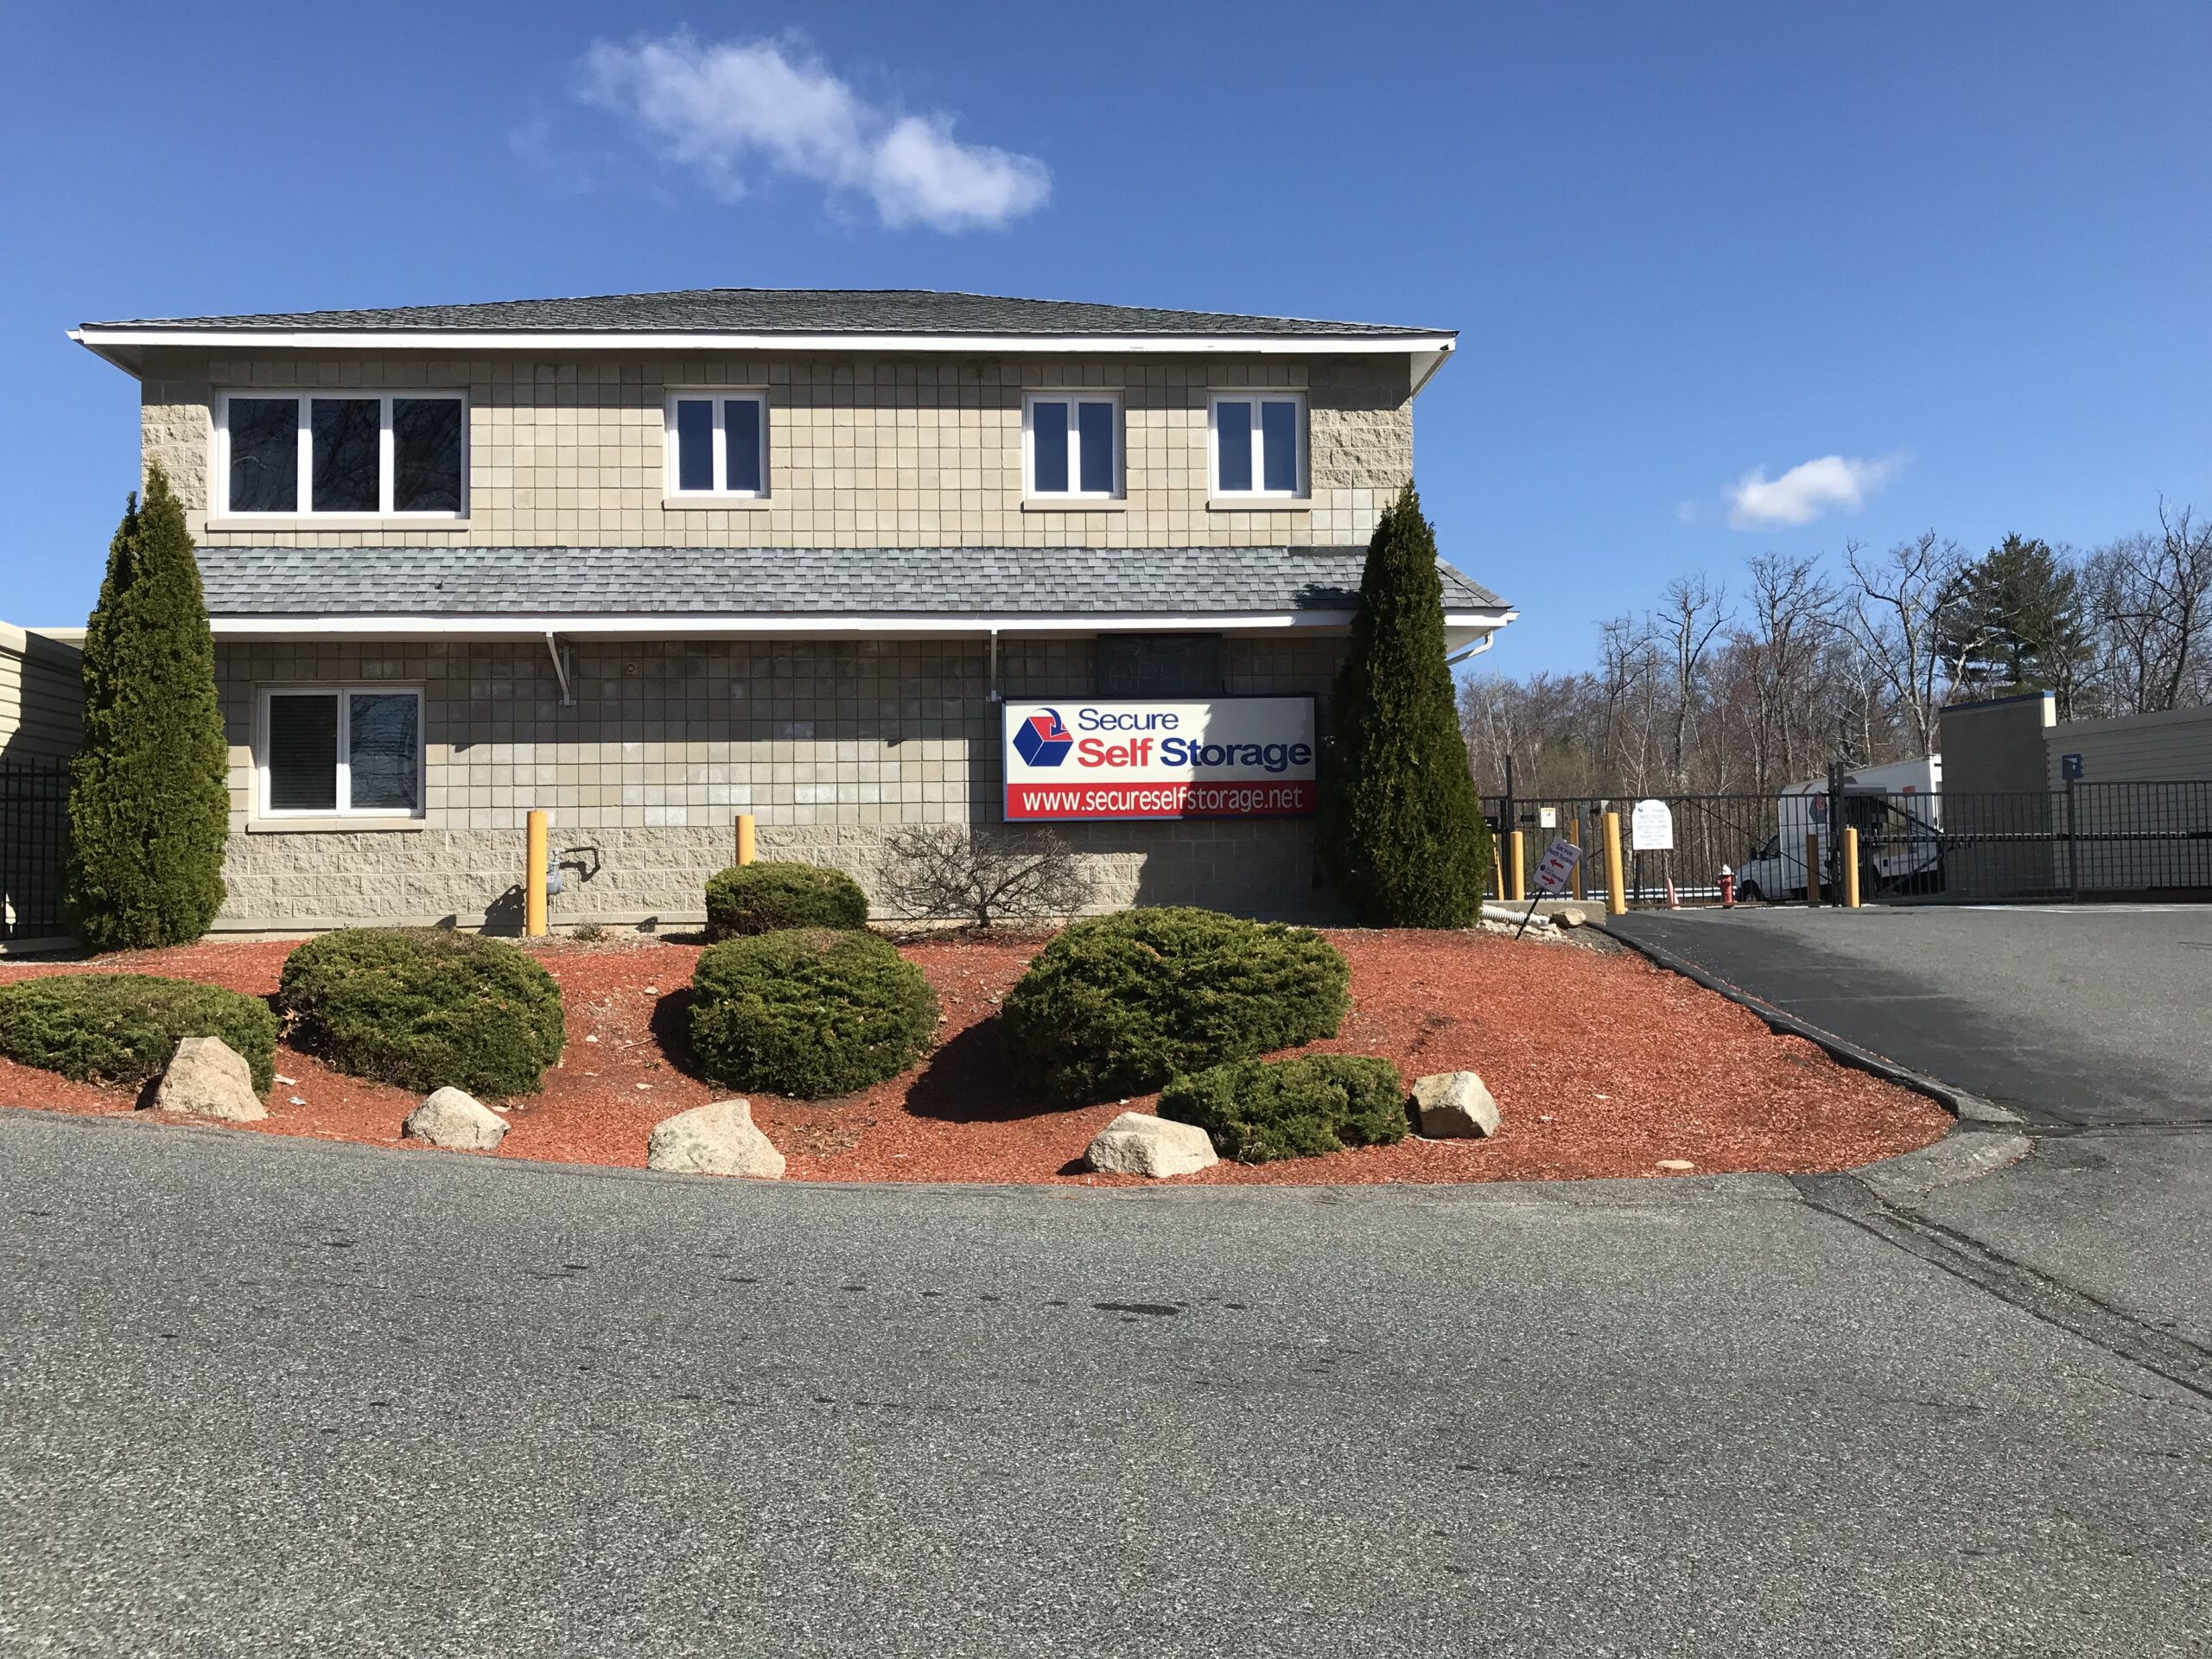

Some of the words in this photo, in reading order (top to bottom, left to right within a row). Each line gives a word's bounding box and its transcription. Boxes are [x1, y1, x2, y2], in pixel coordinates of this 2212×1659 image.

[1109, 659, 1203, 691] OPEN
[1077, 709, 1179, 730] Secure
[1077, 737, 1154, 767] Self
[1160, 737, 1313, 772] Storage
[1022, 786, 1303, 813] www.secureselfstorage.net
